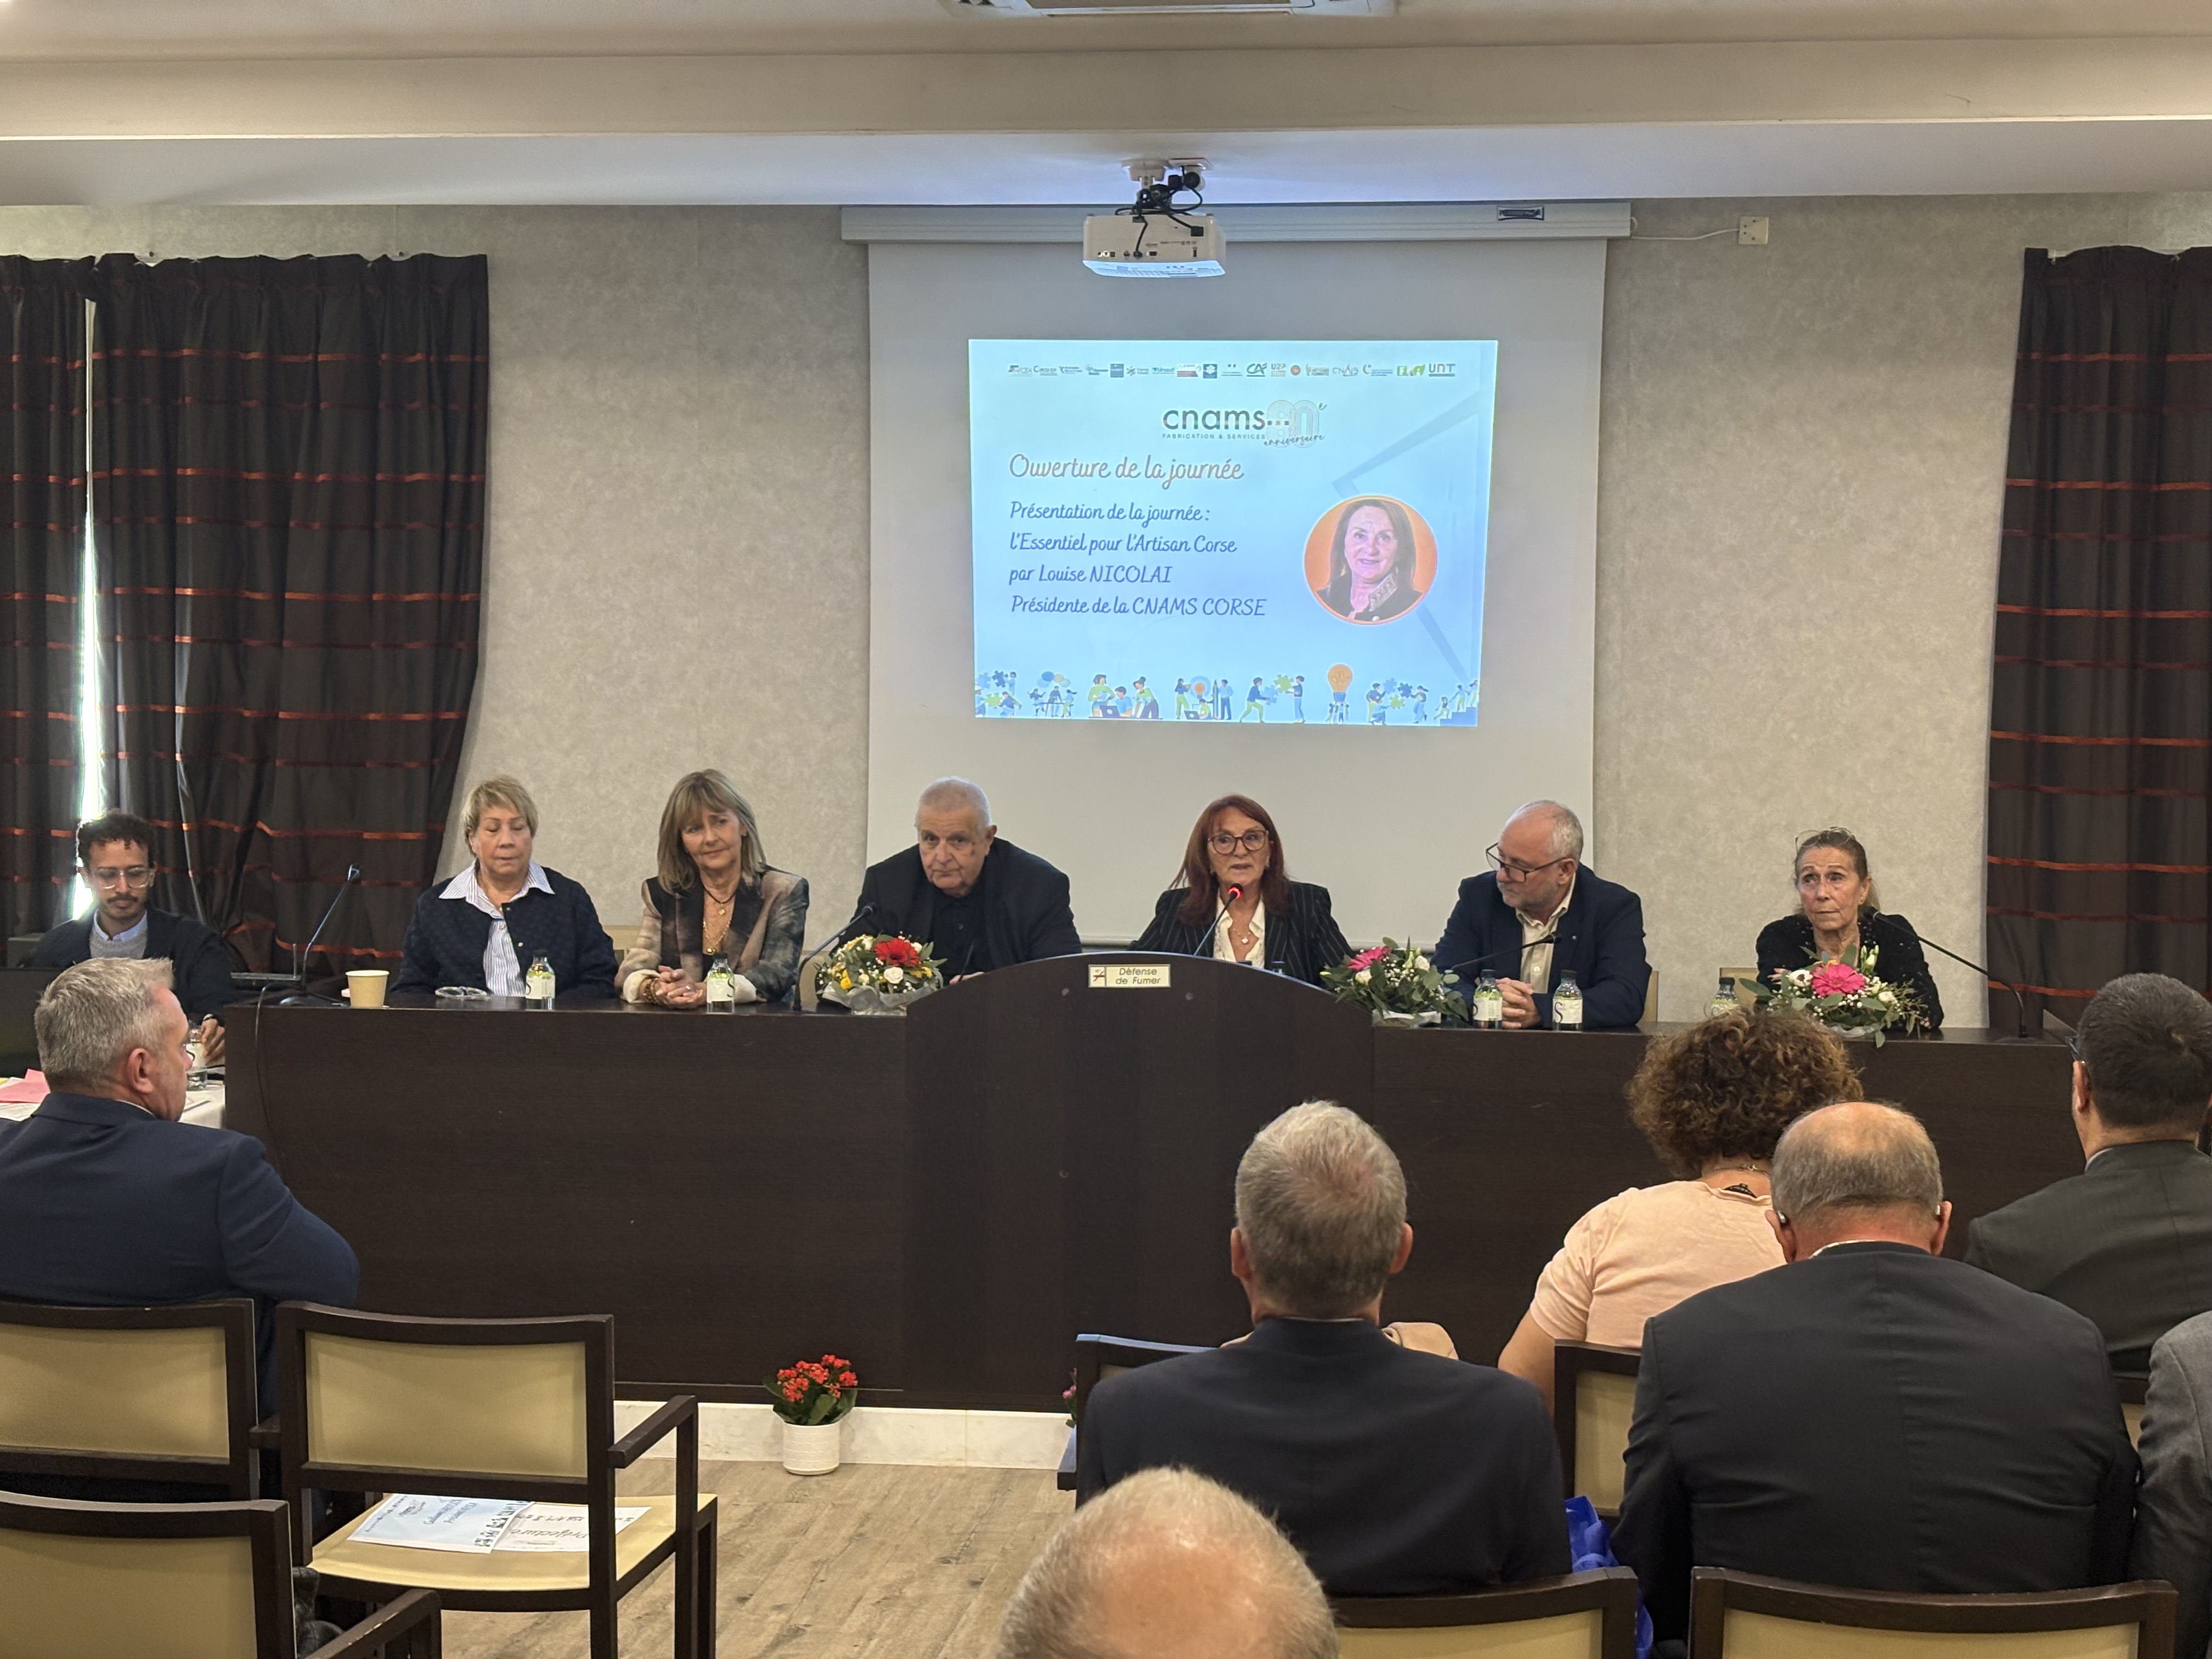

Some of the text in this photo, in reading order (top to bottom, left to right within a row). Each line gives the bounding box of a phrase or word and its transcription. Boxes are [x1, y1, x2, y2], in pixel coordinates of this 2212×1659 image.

[1263, 434, 1325, 447] anniversaire
[1009, 453, 1244, 490] Ouverture de la journée
[1009, 501, 1104, 520] Présentation
[1107, 503, 1126, 520] de
[1129, 502, 1146, 520] la
[1142, 504, 1203, 528] journée
[1088, 537, 1122, 555] pour
[1194, 535, 1238, 553] Corse
[1009, 564, 1172, 585] par Louise NICOLAI
[1012, 595, 1267, 616] Présidente de la CNAMS CORSE
[1119, 967, 1158, 976] Défense
[1132, 977, 1161, 985] Fumer
